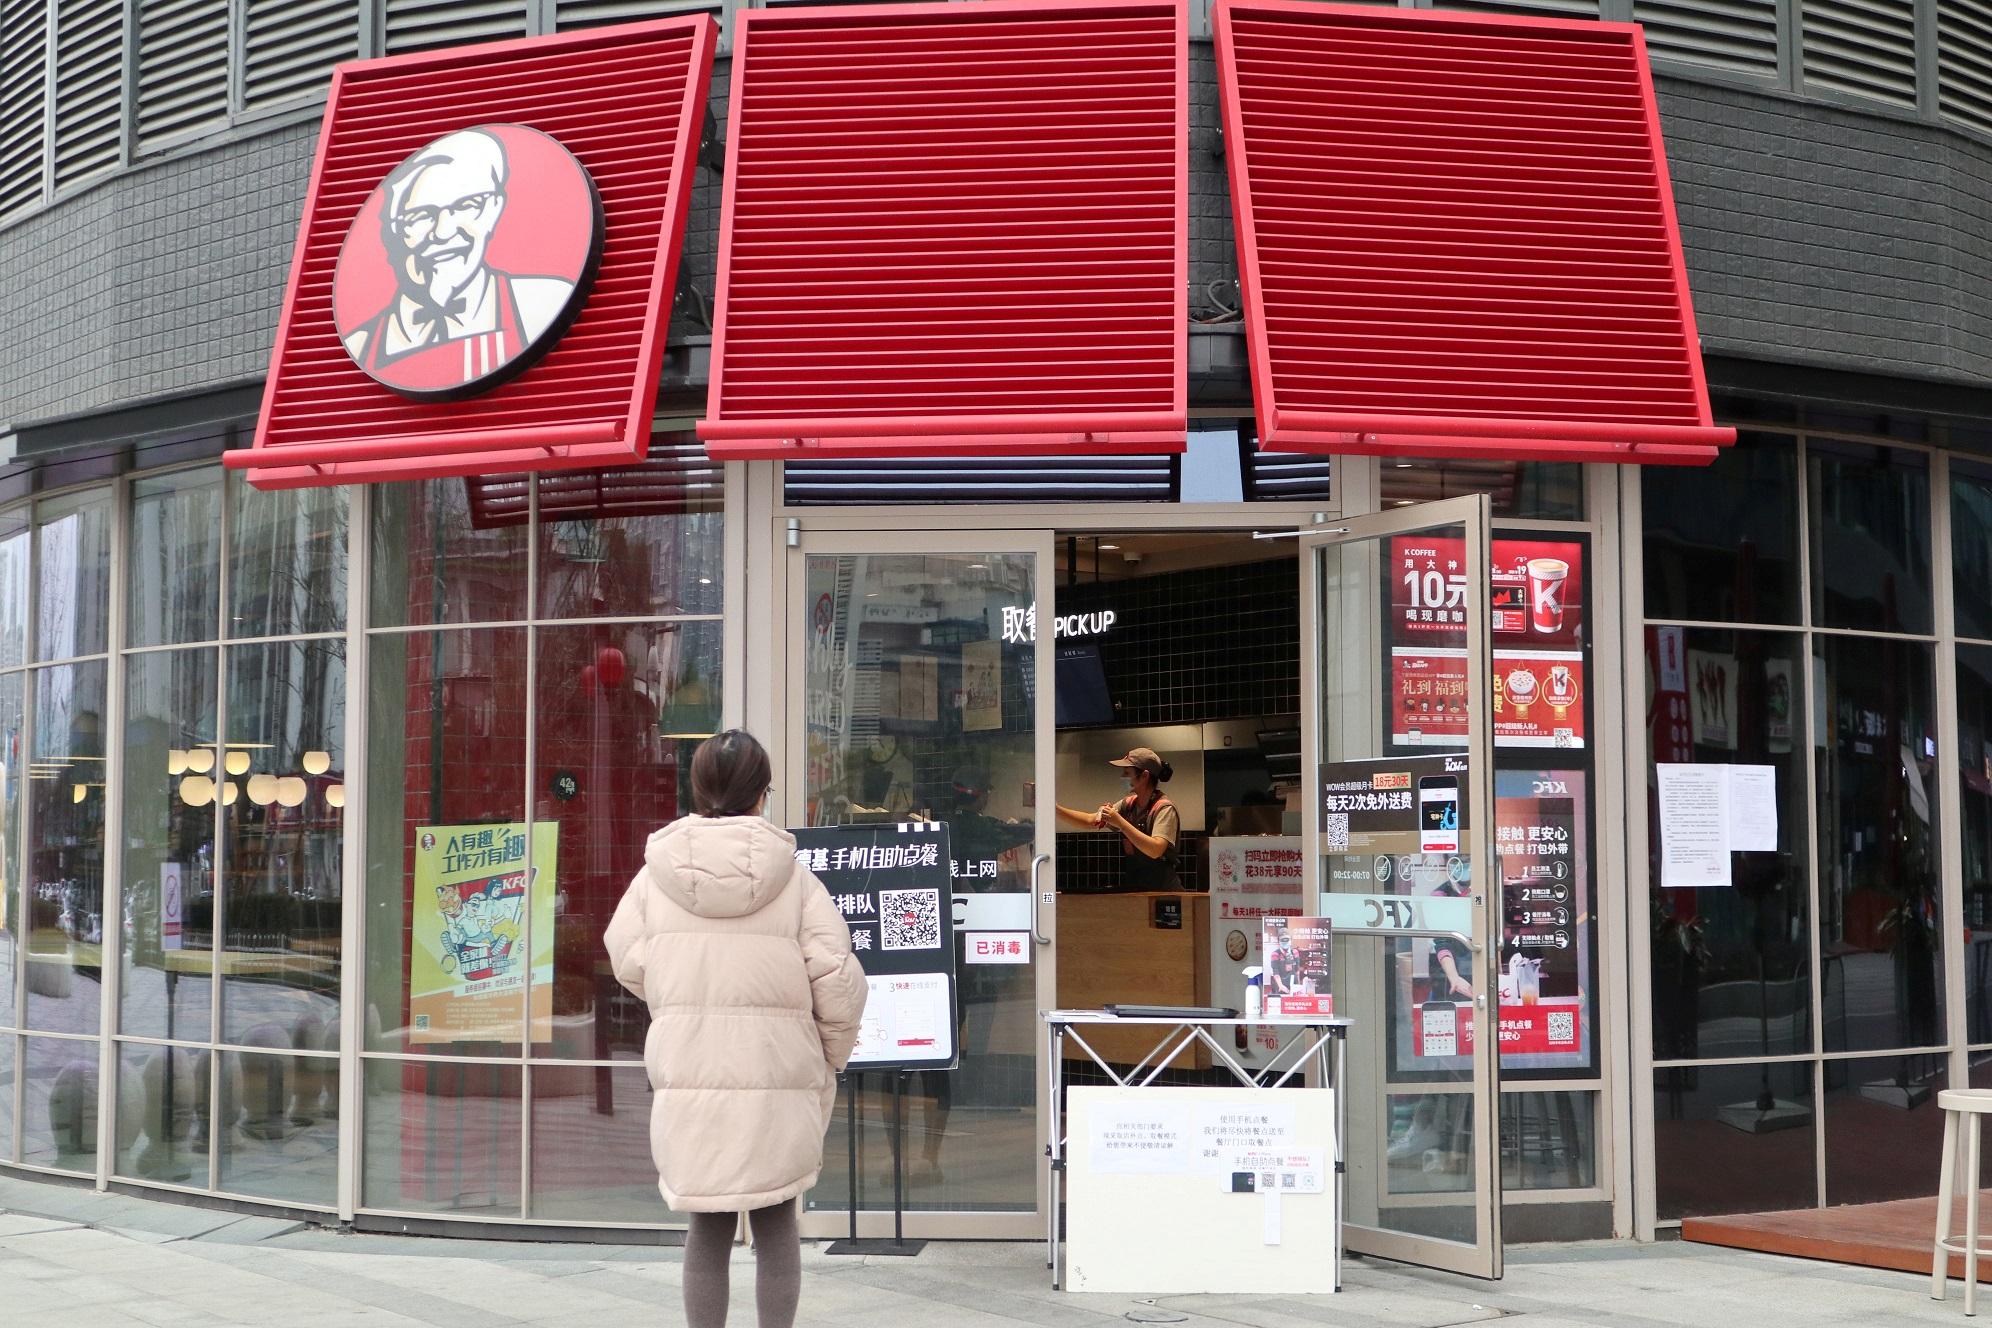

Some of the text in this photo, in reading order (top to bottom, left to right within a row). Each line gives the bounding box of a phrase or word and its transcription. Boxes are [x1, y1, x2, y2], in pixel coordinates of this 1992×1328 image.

[1404, 570, 1467, 608] 10元
[1402, 680, 1468, 696] 礼到 福到
[1374, 775, 1408, 787] 18元30天
[1326, 792, 1413, 811] 每天2次免外送费
[1528, 826, 1568, 840] 更安心
[446, 829, 493, 854] 人有趣
[1527, 843, 1568, 855] 打包外带
[1246, 865, 1302, 877] 花38元享90天
[1522, 866, 1528, 878] 1
[1044, 894, 1052, 902] 拉
[1521, 889, 1530, 900] 2
[1522, 912, 1530, 924] 3
[852, 930, 872, 950] 餐
[1511, 936, 1520, 947] 4
[977, 941, 1021, 955] 已消毒
[1500, 1020, 1532, 1030] 手机点餐
[1265, 1038, 1274, 1049] 10
[1220, 1115, 1268, 1124] 使用手机点餐
[1216, 1138, 1272, 1146] 餐厅门口取餐点
[1234, 1156, 1284, 1167] 手机自助点餐
